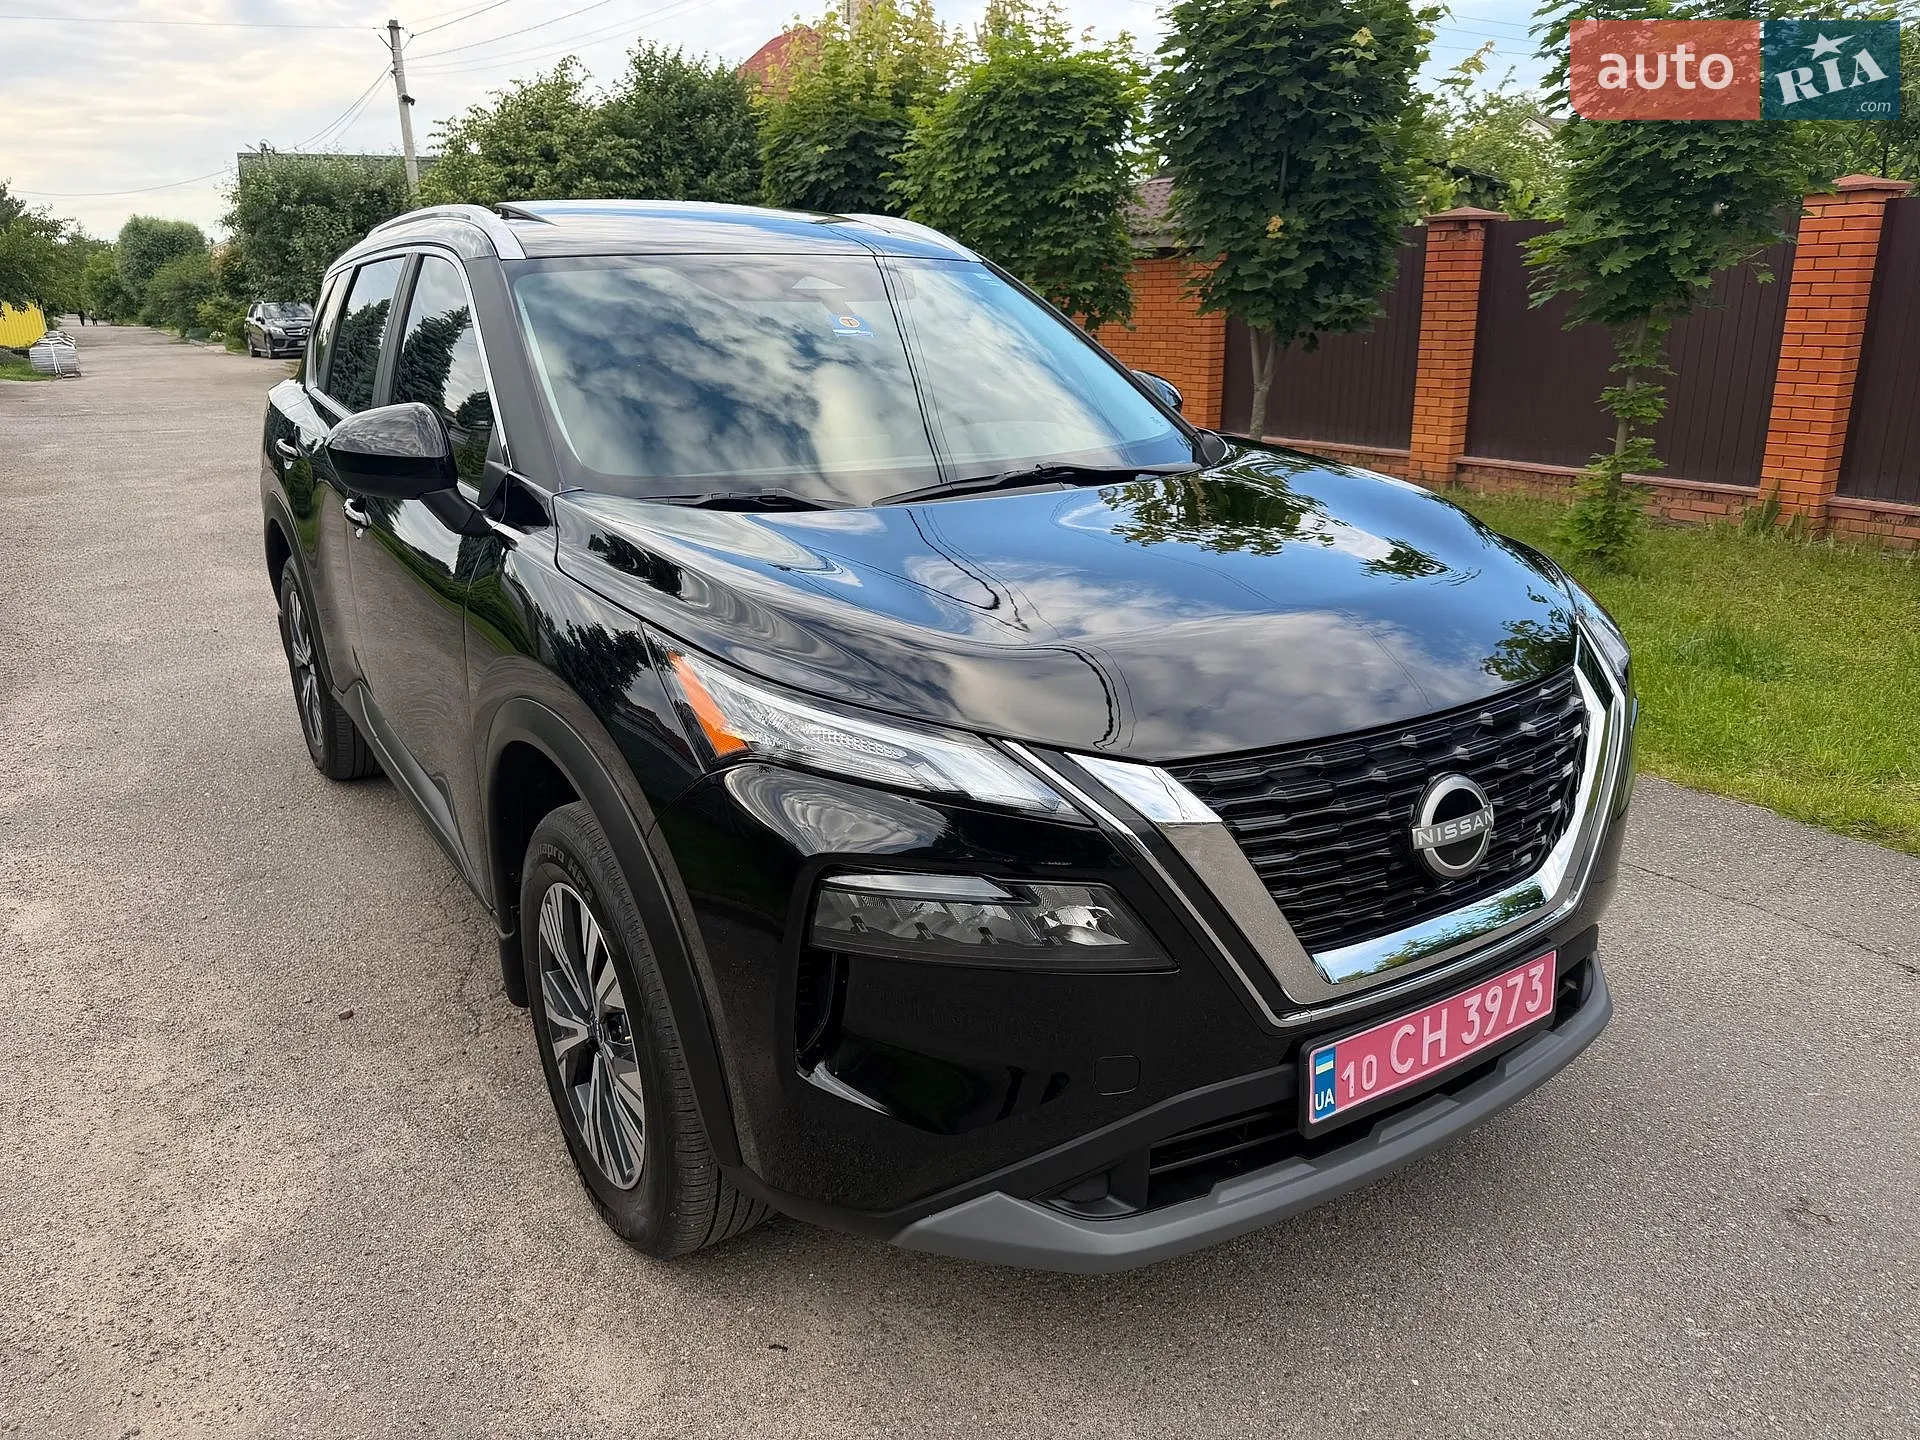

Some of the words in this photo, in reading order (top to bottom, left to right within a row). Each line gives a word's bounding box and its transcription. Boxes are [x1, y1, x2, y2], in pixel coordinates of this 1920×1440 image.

[1417, 810, 1493, 846] NISSAN
[1341, 1054, 1377, 1099] 10
[1390, 1008, 1448, 1075] CH
[1461, 963, 1545, 1045] 3973
[1315, 1088, 1335, 1111] UA
